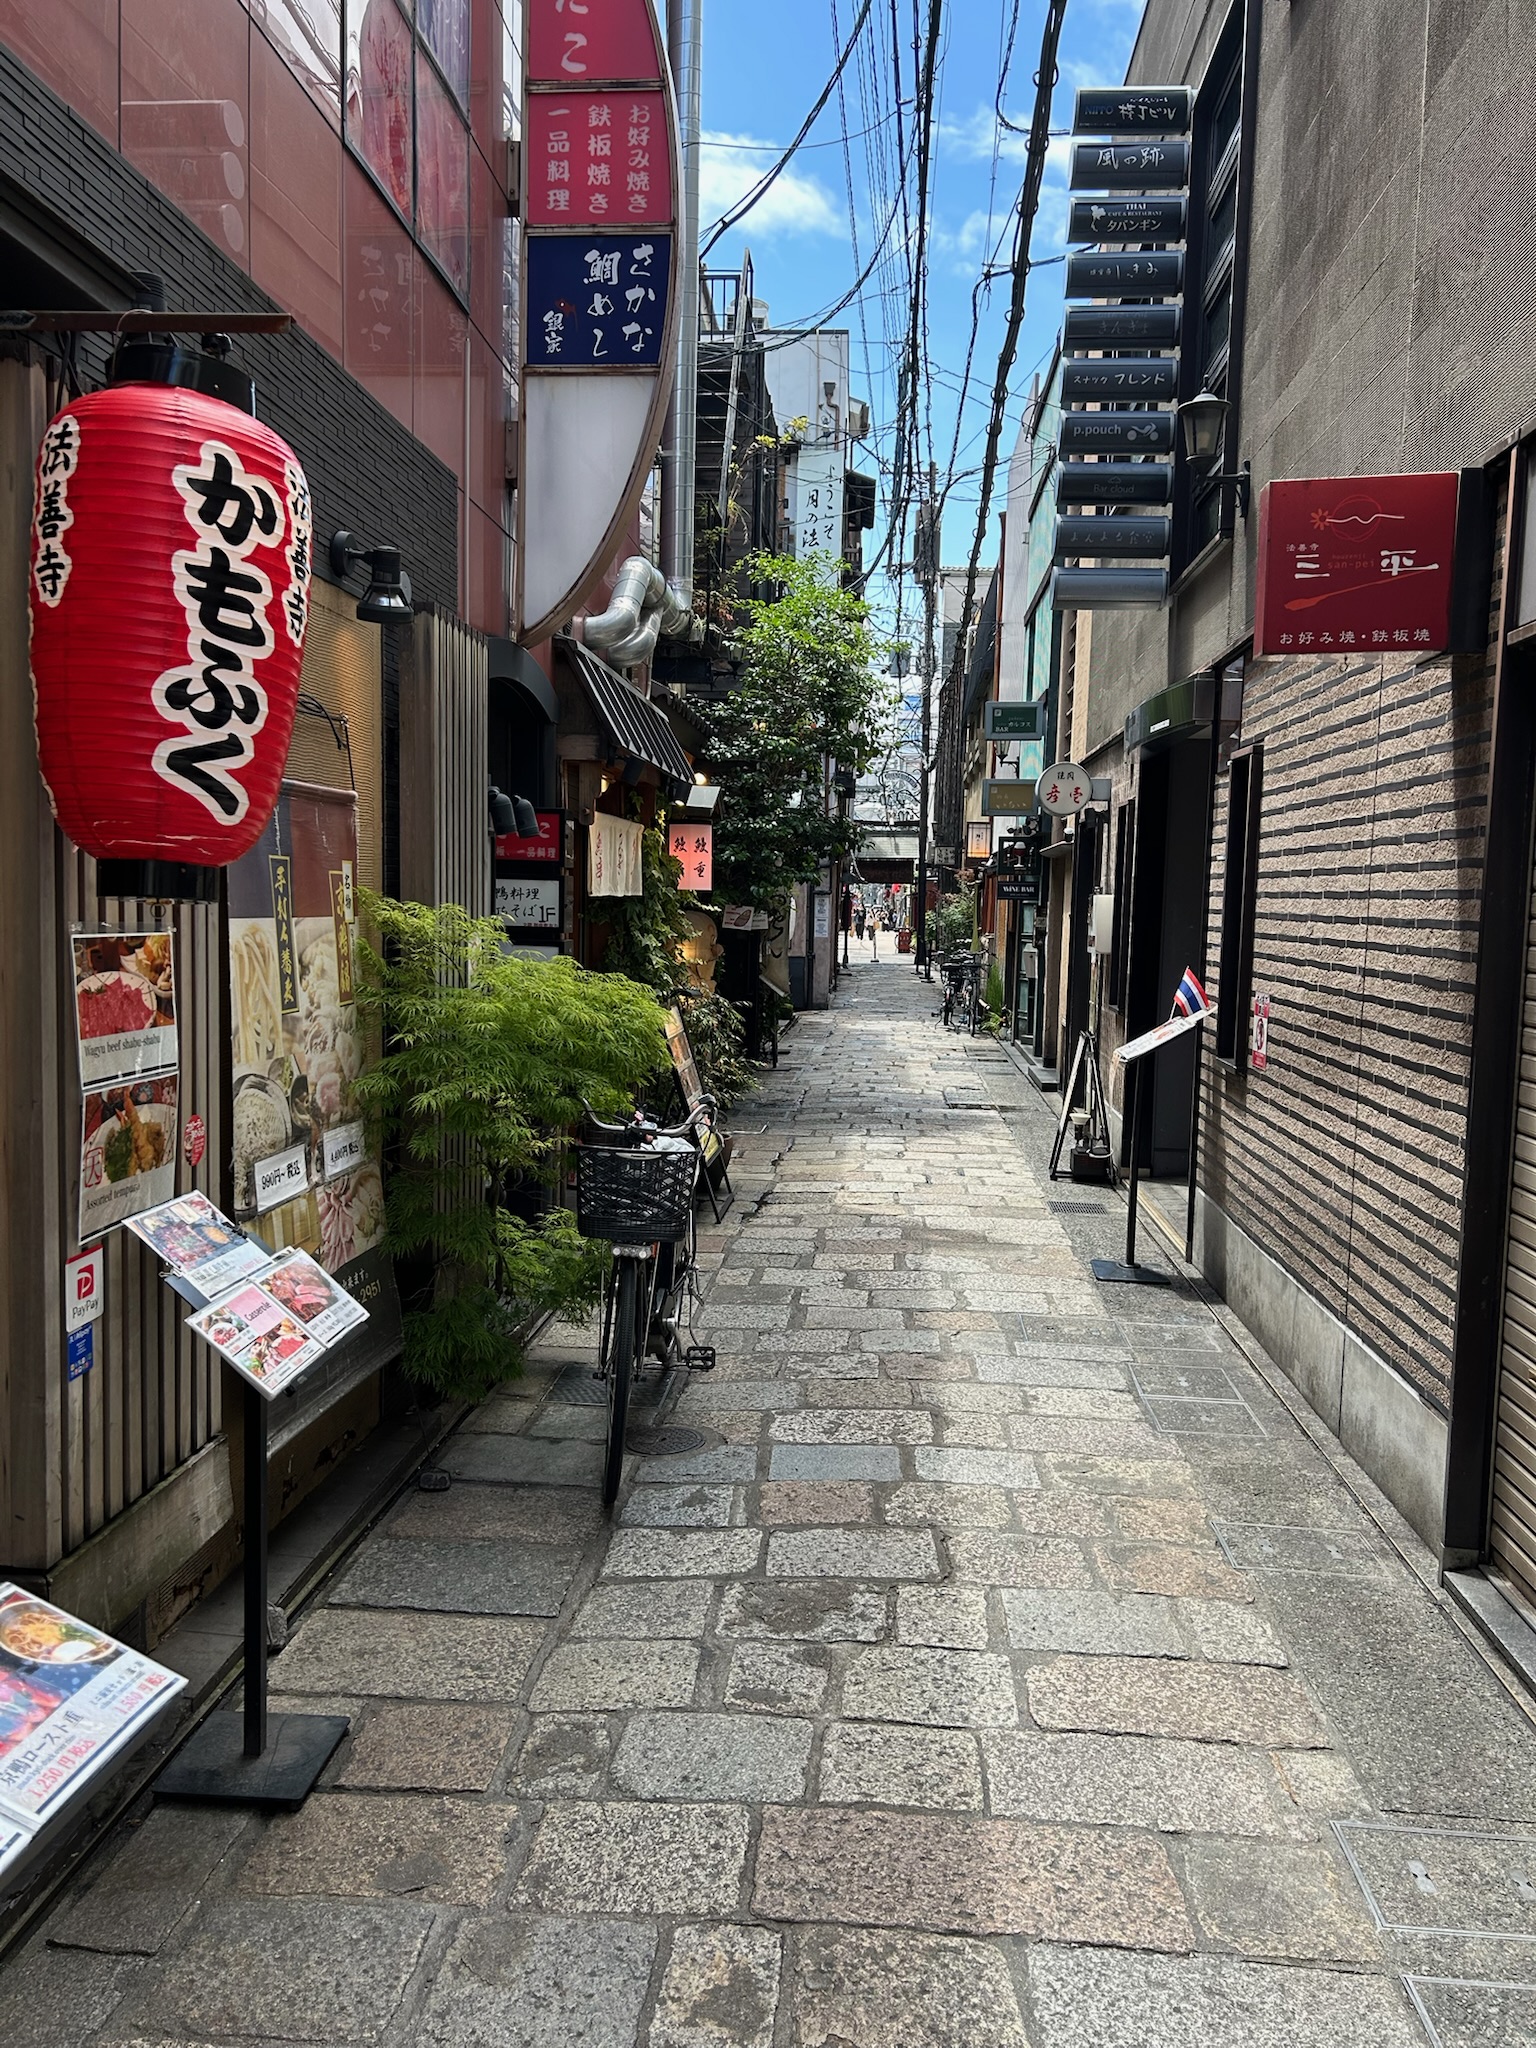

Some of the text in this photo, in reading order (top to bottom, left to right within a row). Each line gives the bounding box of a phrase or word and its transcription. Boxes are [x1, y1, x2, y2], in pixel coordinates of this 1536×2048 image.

[547, 107, 571, 211] 一品料理
[587, 104, 612, 213] 鉄板焼き
[627, 105, 651, 213] お好み焼き
[583, 249, 621, 357] 鯛めし
[622, 243, 656, 352] さかな
[1073, 373, 1166, 385] スナック フレンド
[1073, 424, 1122, 437] p.pouch
[1093, 484, 1135, 493] Bar cloud
[34, 422, 72, 599] 法善寺
[802, 489, 820, 558] 月の法
[1327, 558, 1375, 571] san-pei
[165, 453, 278, 817] かもふく
[539, 905, 556, 923] 1F
[84, 1033, 161, 1058] Wagyu beef shabu-shabu
[85, 1183, 141, 1212] Assorted tempura
[72, 1299, 99, 1319] PayPay
[244, 1300, 273, 1323] Casserole
